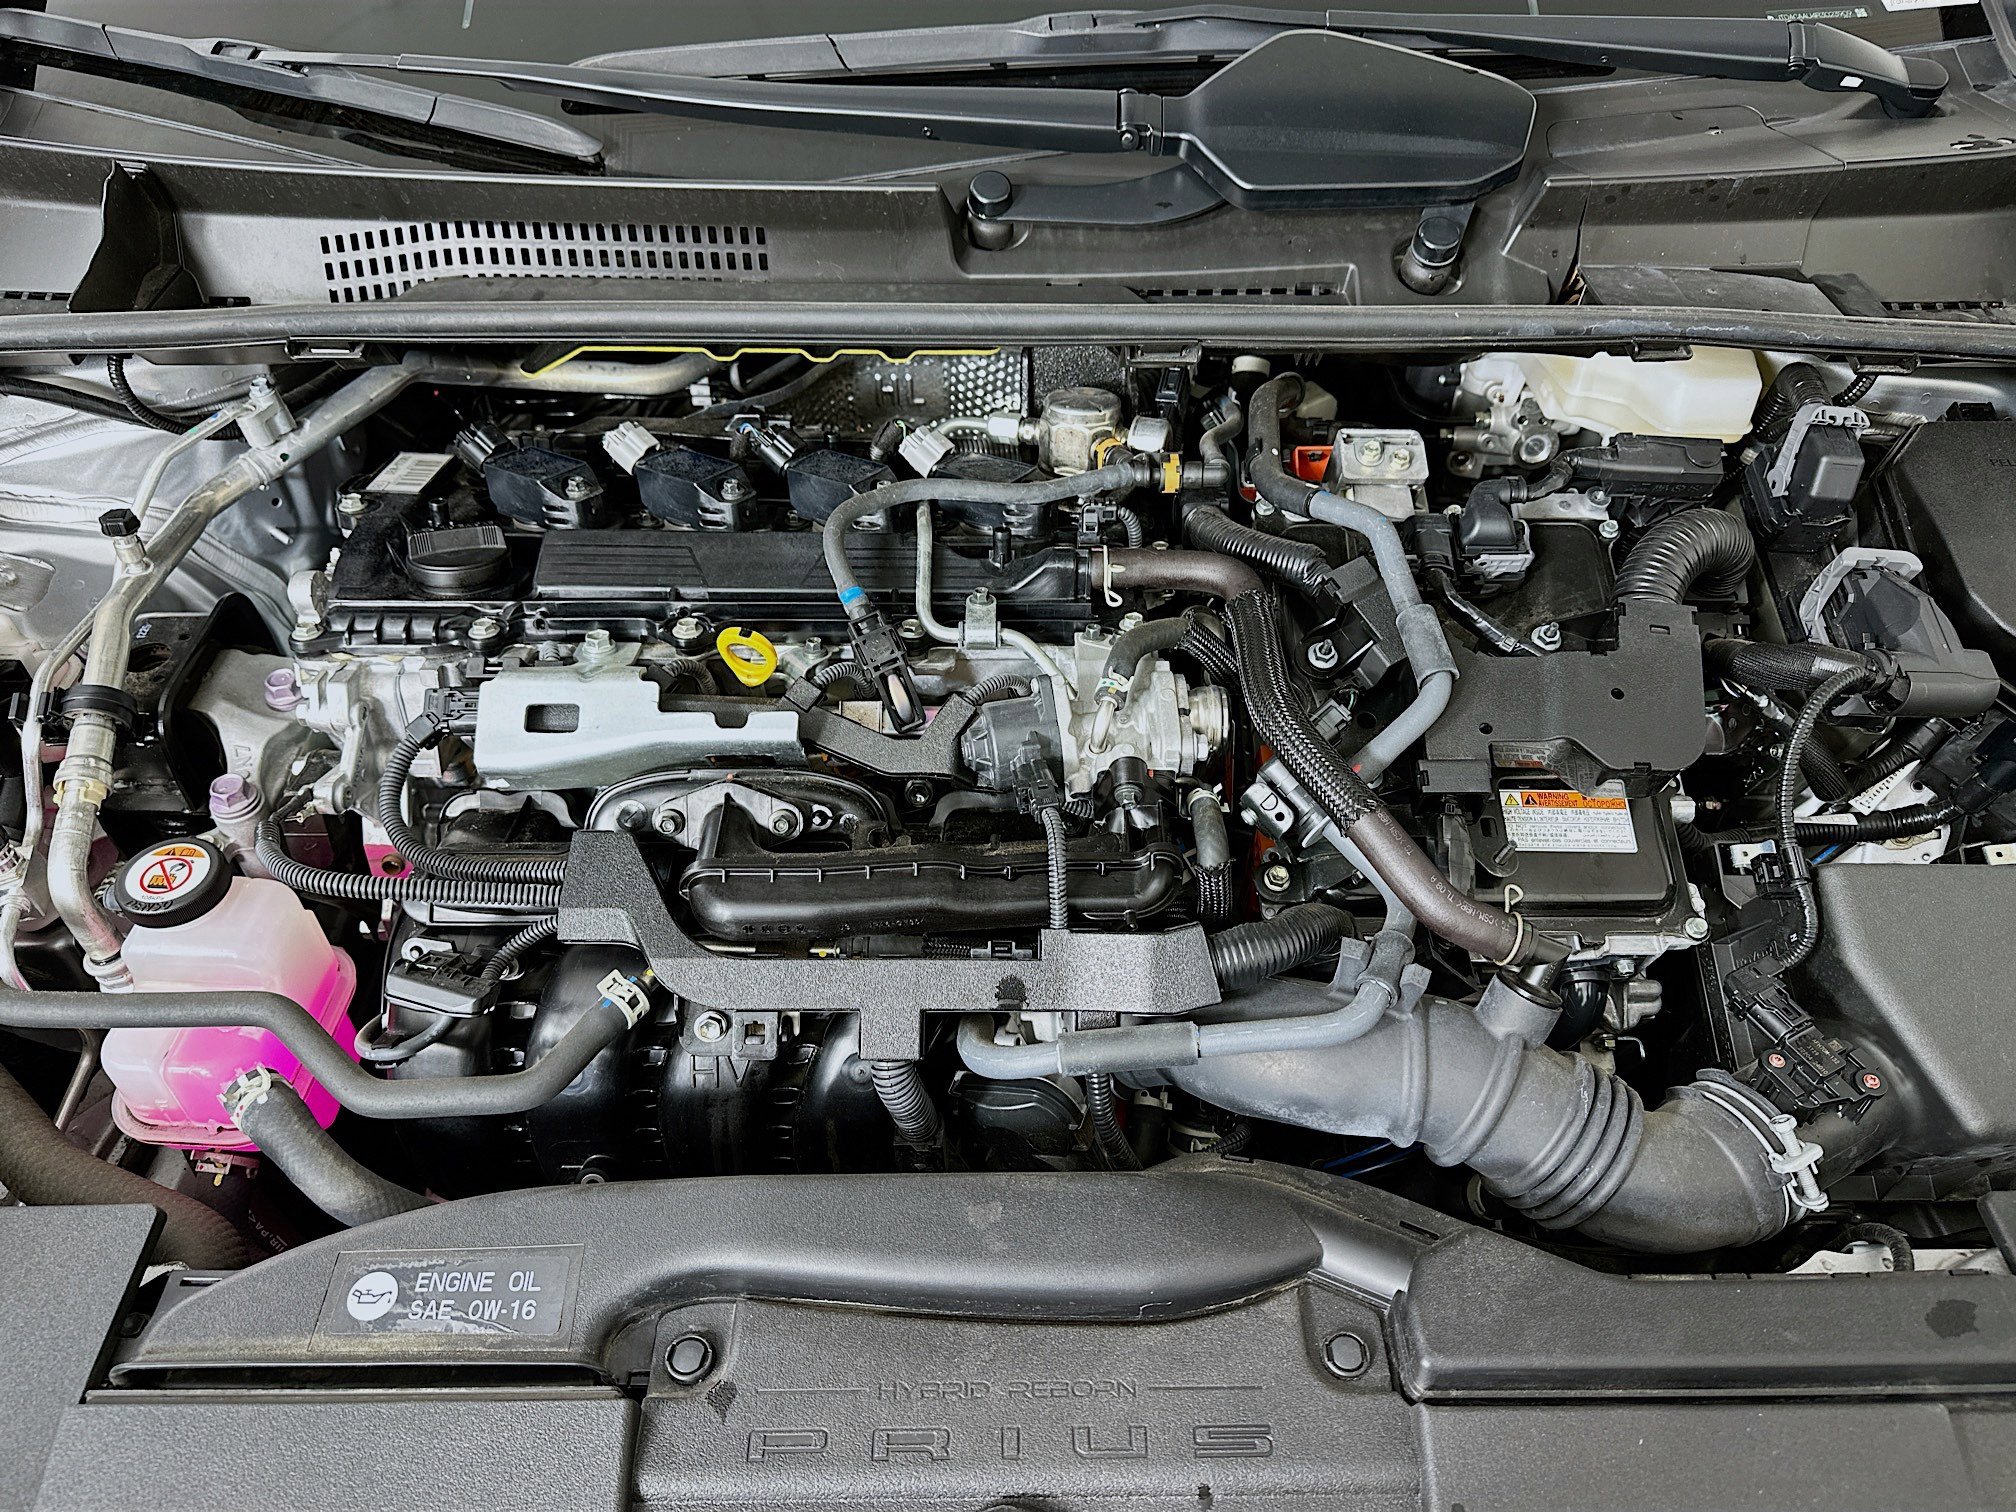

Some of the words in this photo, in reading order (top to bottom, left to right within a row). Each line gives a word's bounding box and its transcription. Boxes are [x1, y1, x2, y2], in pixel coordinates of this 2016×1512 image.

[1537, 792, 1569, 800] WARNING
[414, 1271, 495, 1292] ENGINE
[508, 1271, 541, 1292] OIL
[408, 1299, 455, 1320] SAE
[468, 1299, 537, 1320] 0W-16
[878, 1379, 992, 1399] HYBRID
[1008, 1379, 1138, 1399] REBORN
[747, 1424, 1274, 1463] PRIUS
